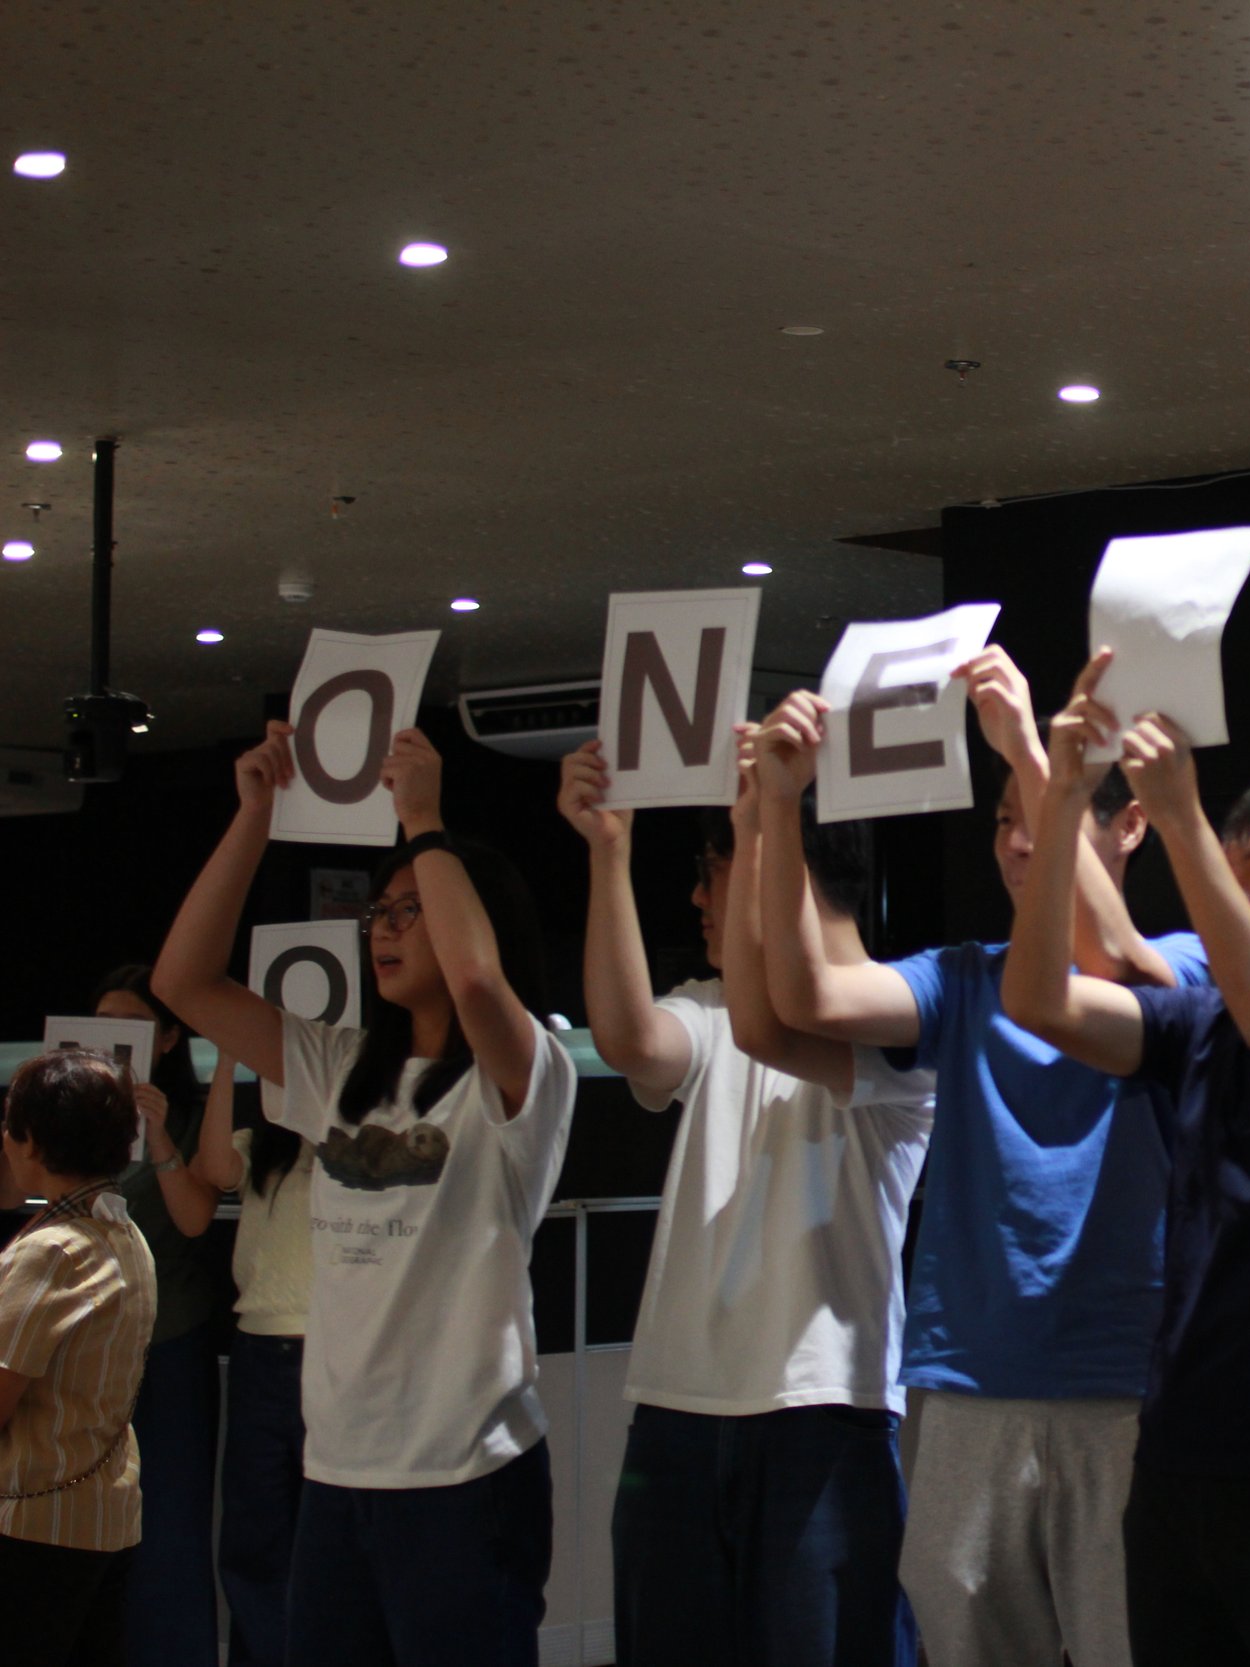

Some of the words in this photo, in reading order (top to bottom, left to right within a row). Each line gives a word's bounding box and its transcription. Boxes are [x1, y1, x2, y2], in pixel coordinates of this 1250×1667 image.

[294, 669, 394, 804] O
[617, 627, 726, 771] N
[849, 638, 958, 777] E
